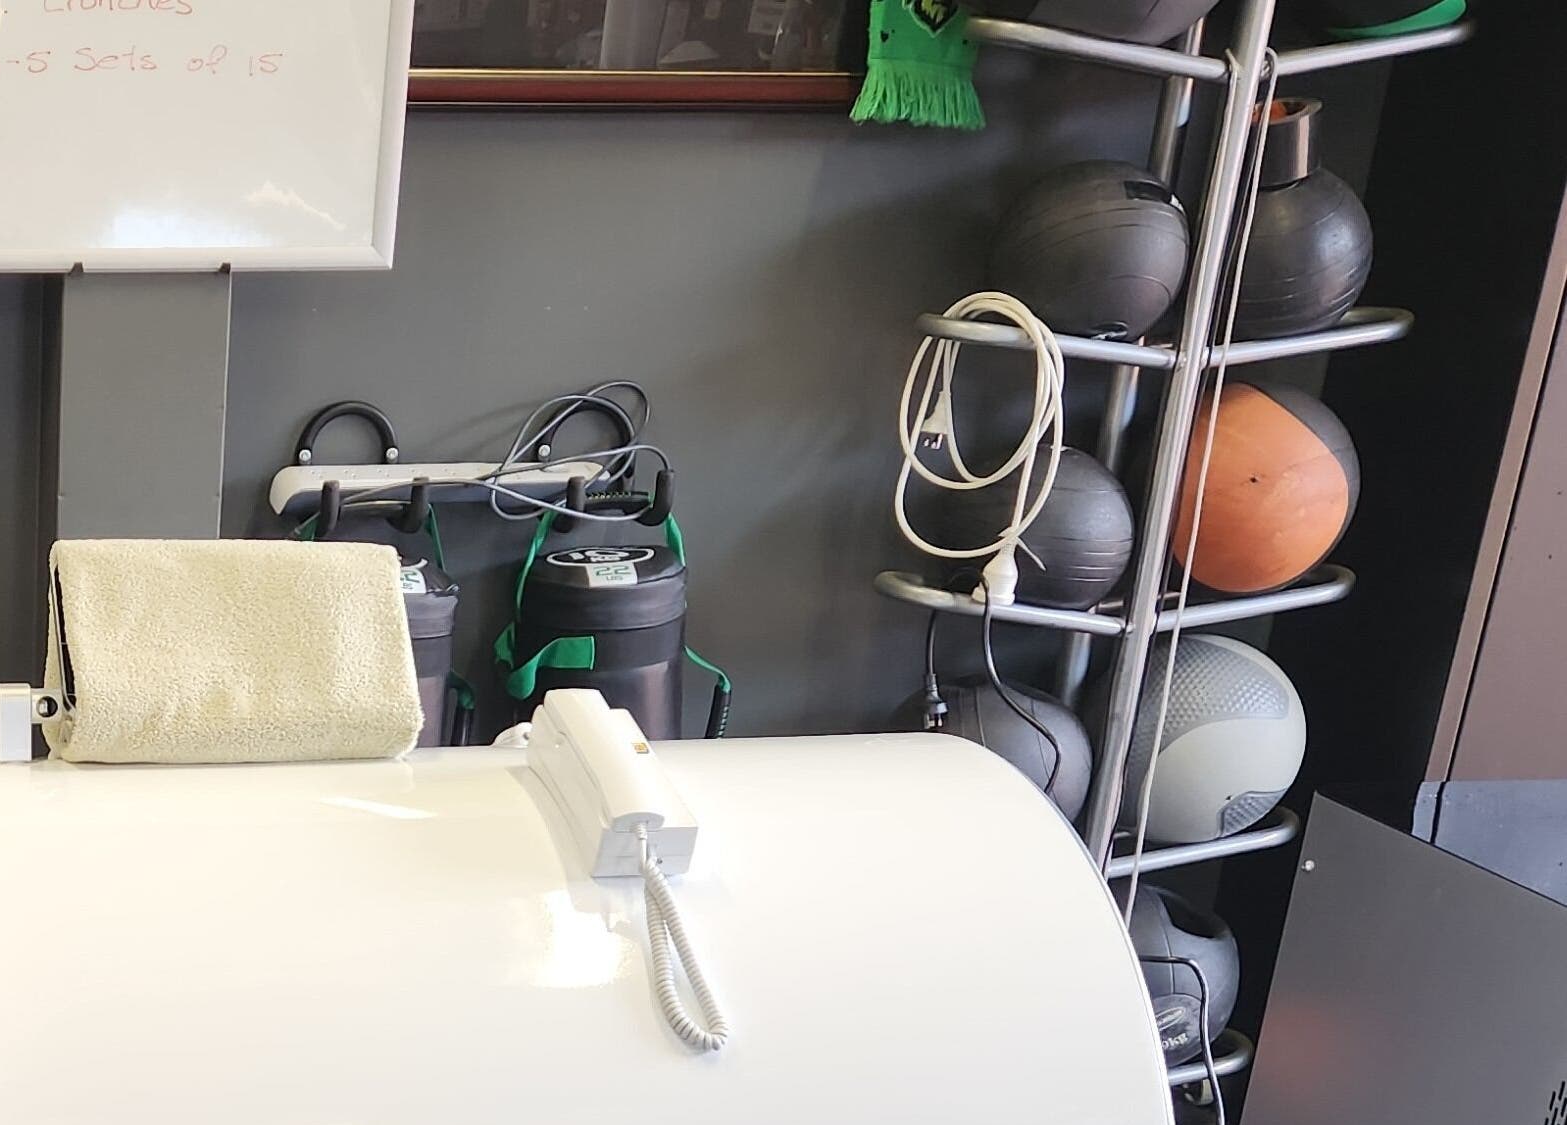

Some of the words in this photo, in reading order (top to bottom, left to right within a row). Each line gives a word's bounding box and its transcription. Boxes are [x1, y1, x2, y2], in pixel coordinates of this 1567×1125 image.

[74, 46, 157, 71] Sets
[187, 44, 228, 75] of
[249, 53, 283, 77] 15
